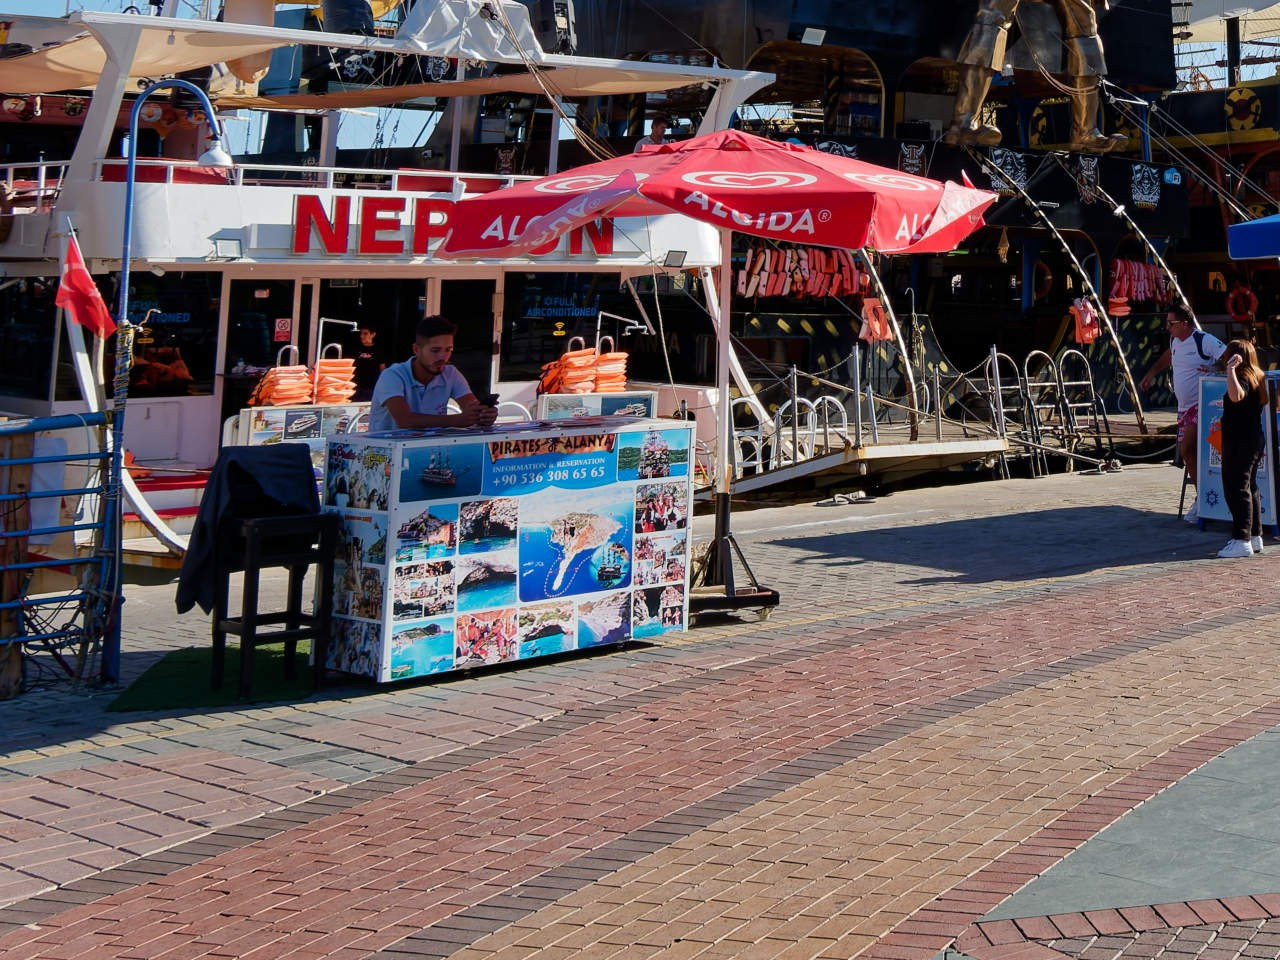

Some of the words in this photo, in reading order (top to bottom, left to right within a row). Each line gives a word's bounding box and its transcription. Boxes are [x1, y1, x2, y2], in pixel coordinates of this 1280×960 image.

[292, 193, 615, 256] NEPN
[491, 439, 540, 455] PIRATES
[564, 434, 613, 450] ALANYA
[492, 463, 547, 474] INFORMATION
[556, 457, 605, 468] RESERVATION
[493, 473, 517, 487] +90
[521, 472, 543, 485] 536
[547, 470, 569, 482] 308
[573, 468, 587, 479] 65
[591, 466, 605, 478] 65
